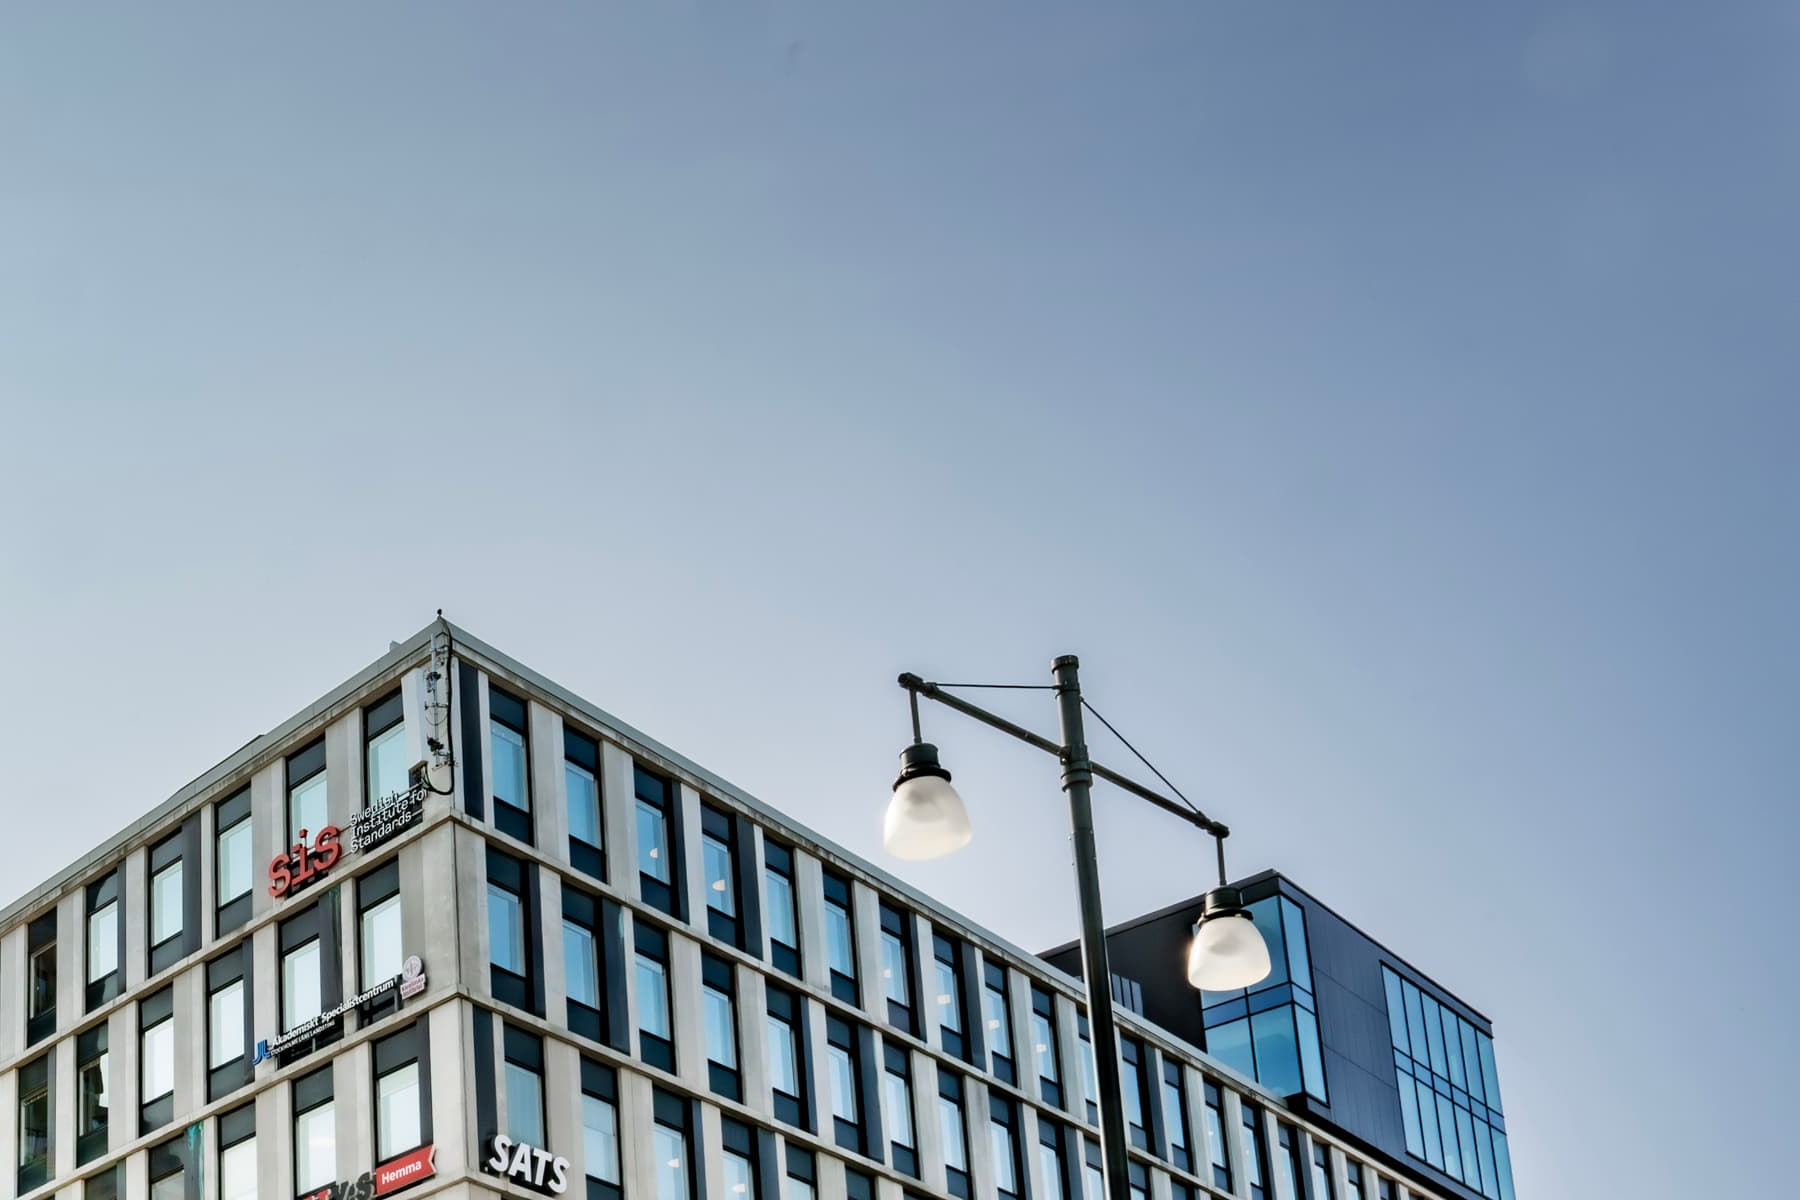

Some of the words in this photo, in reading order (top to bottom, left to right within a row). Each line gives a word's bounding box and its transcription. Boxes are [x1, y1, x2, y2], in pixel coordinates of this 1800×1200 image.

[350, 790, 399, 826] Swedish
[351, 798, 409, 839] Institute
[409, 789, 429, 805] for
[350, 811, 412, 854] Standards
[271, 1015, 319, 1048] Akademiskt
[320, 979, 394, 1025] Specialistcentrum
[381, 1159, 422, 1185] Hemma
[488, 1134, 571, 1194] SATS
